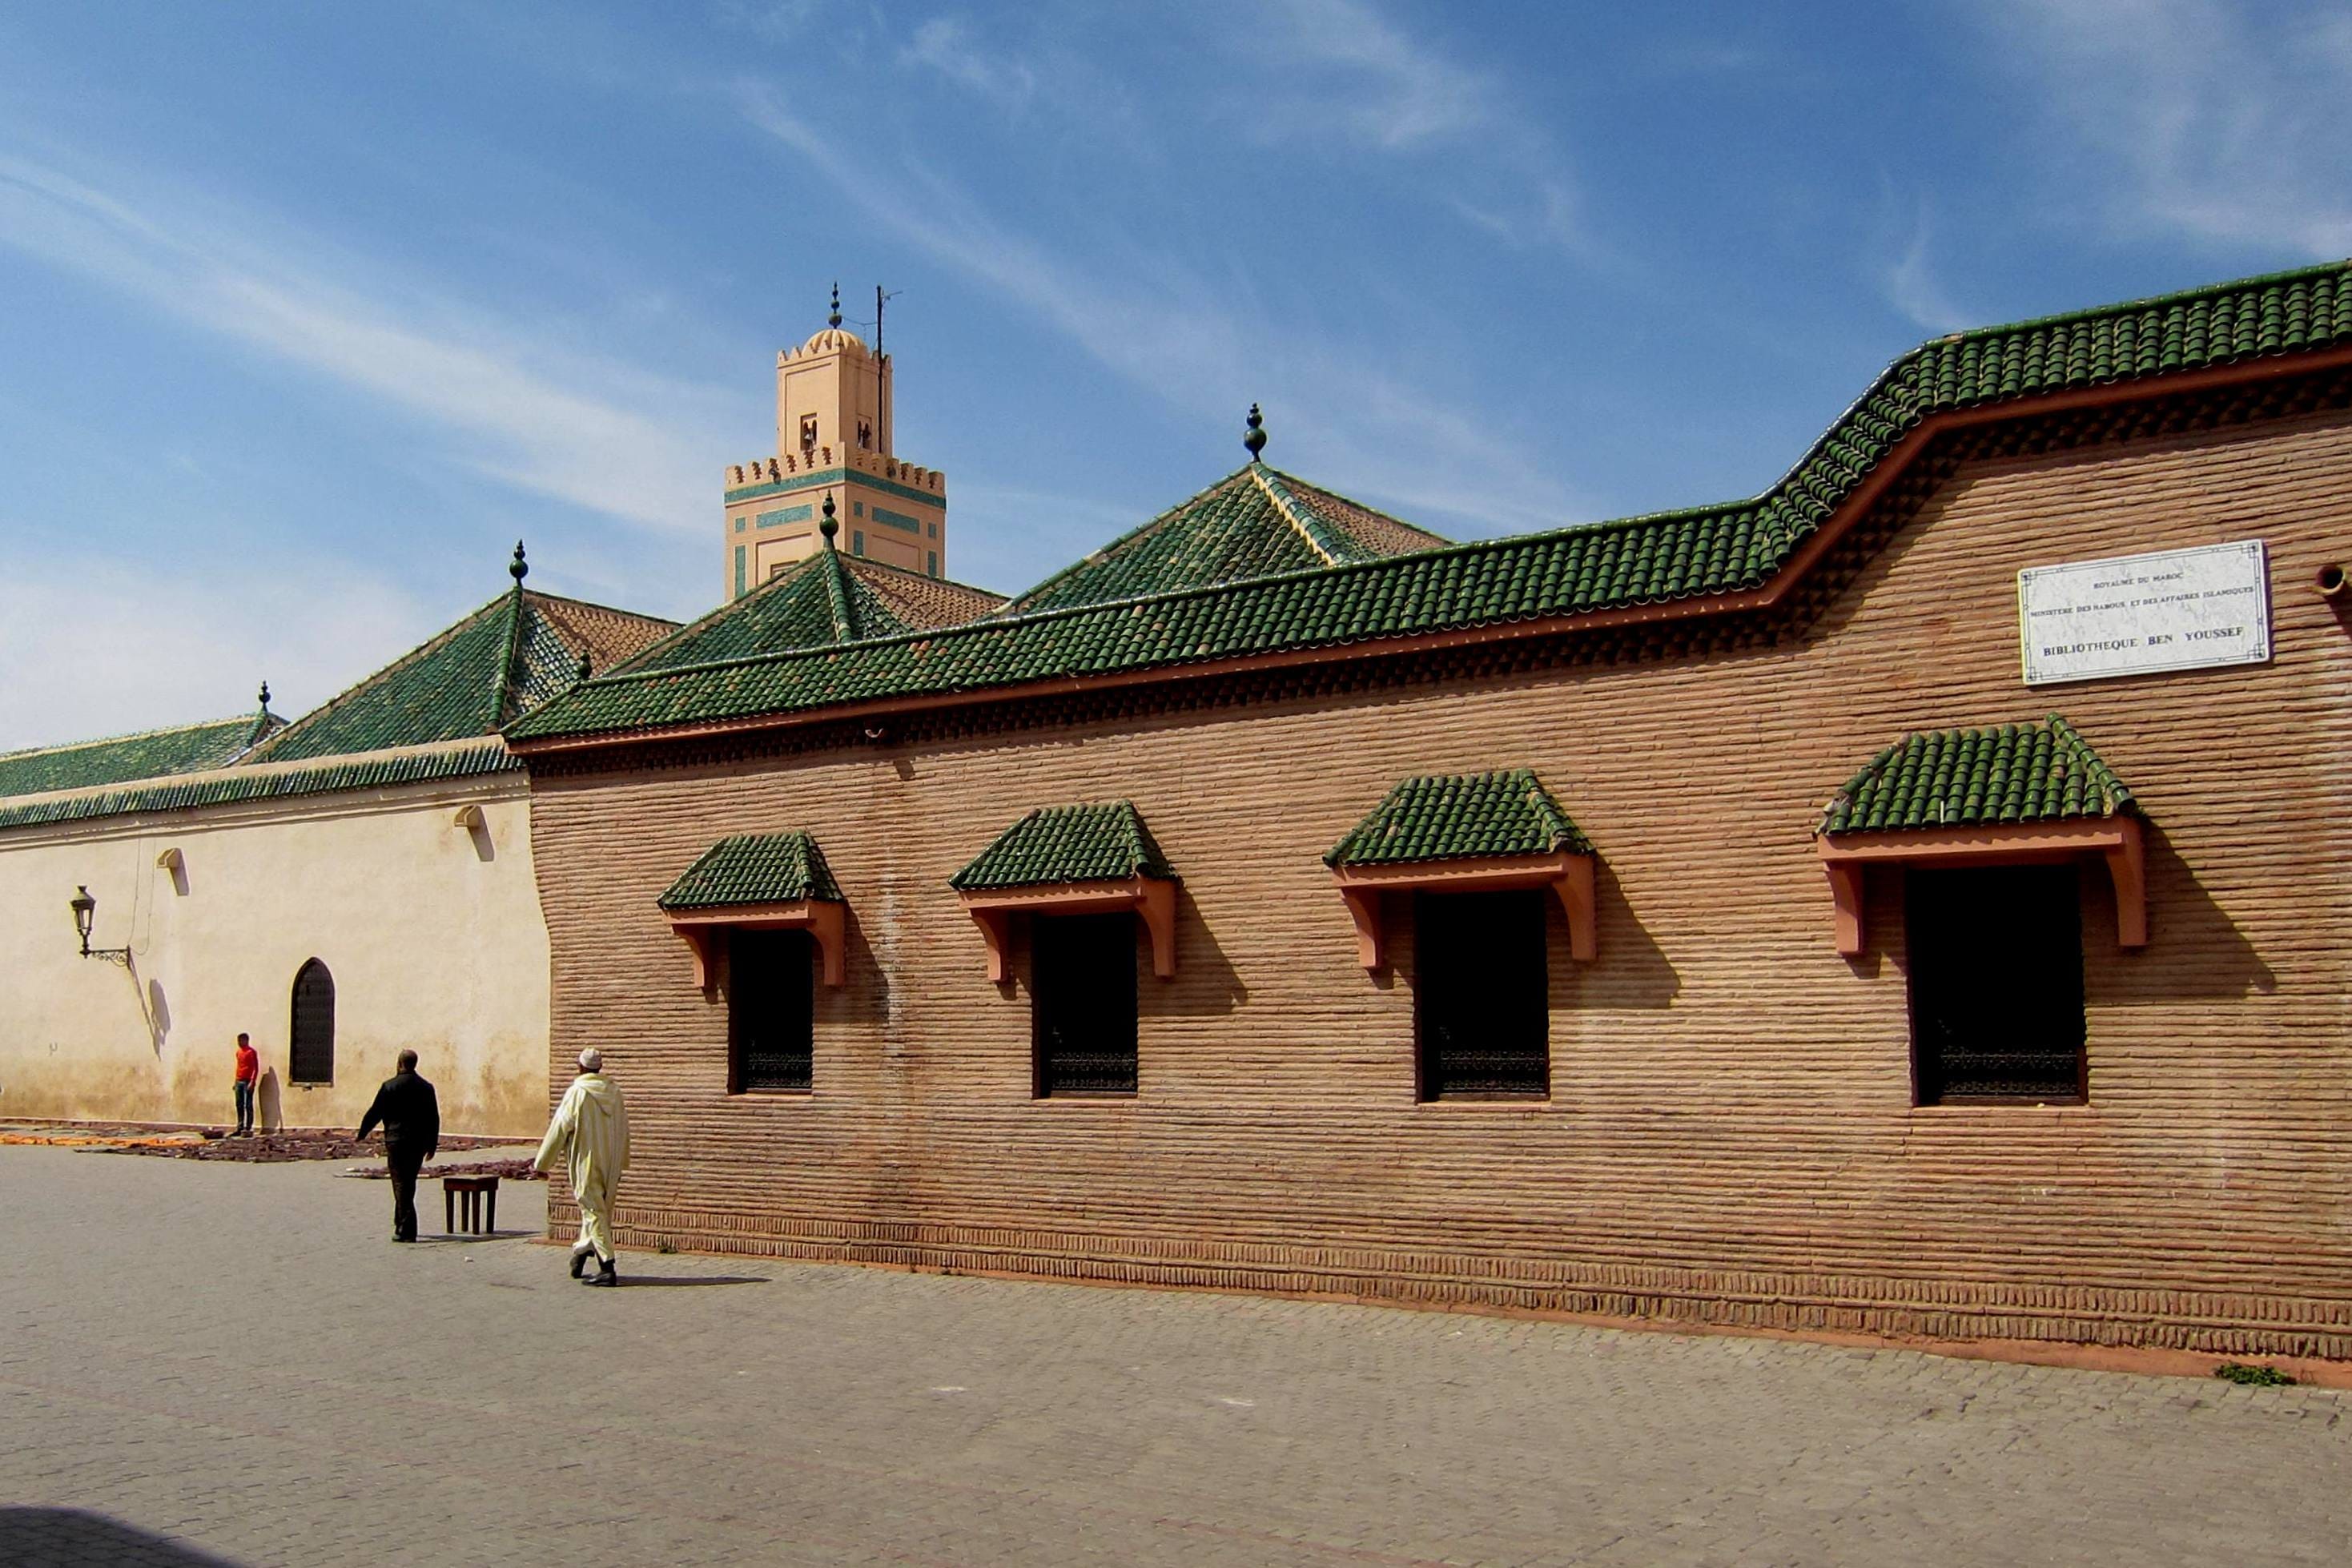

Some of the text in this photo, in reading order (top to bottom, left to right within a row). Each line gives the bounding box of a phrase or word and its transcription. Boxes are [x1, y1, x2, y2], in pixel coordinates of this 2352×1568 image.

[2137, 577, 2149, 585] DU
[2153, 572, 2184, 581] MAROC
[2077, 605, 2091, 613] DES
[2143, 597, 2158, 605] DES
[2160, 593, 2200, 603] AFFAIRES
[2203, 585, 2254, 598] ISLAMIQUES
[2043, 626, 2244, 657] BIBLIOTHEQUE BEN YOUSSEF
